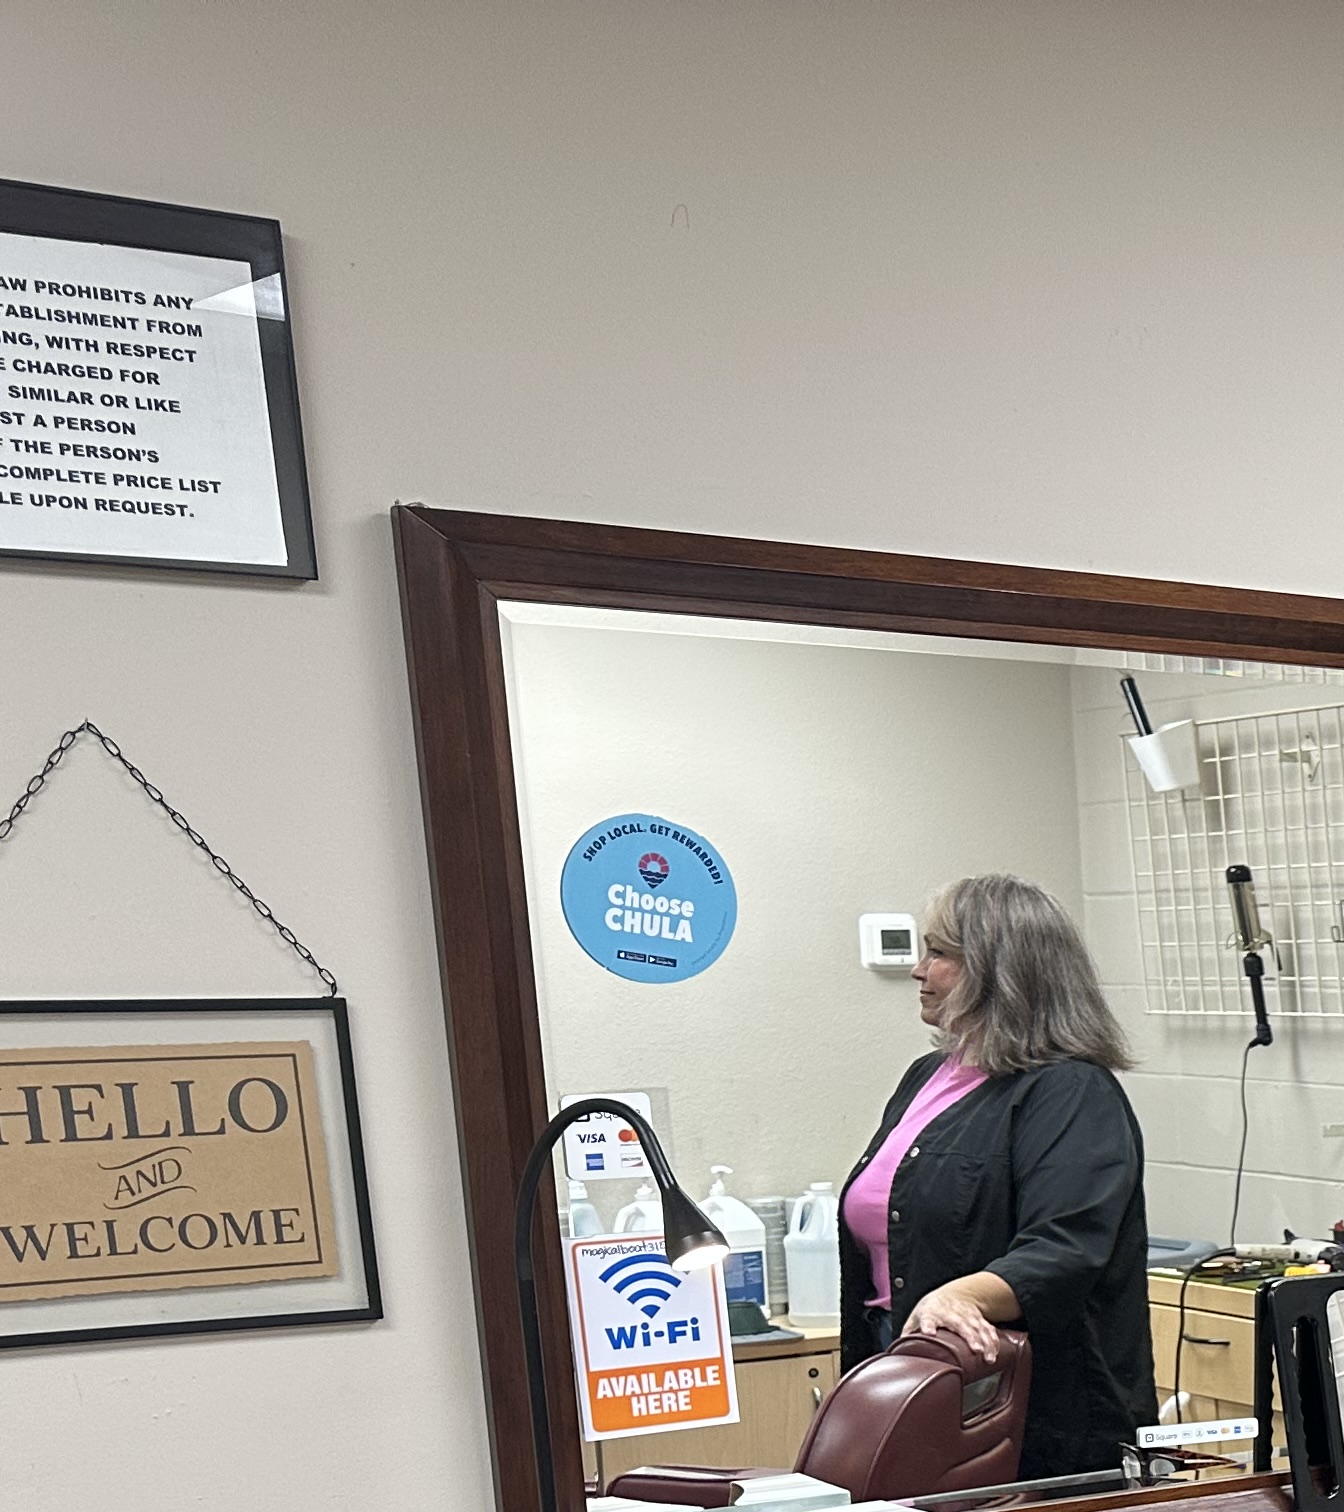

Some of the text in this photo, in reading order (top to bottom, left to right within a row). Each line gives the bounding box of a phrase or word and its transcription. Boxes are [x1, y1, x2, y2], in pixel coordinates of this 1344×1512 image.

[34, 280, 146, 305] PROHIBITS
[153, 294, 194, 310] ANY
[146, 319, 203, 338] FROM
[0, 330, 197, 363] NG, WITH RESPECT
[13, 358, 113, 381] CHARGED
[119, 369, 160, 386] FOR
[8, 385, 181, 413] SIMILAR OR LIKE
[33, 414, 48, 428] A
[53, 416, 136, 435] PERSON
[10, 438, 53, 455] THE
[0, 464, 221, 494] COMPLETE PRICE LIST
[29, 493, 88, 510] UPON
[94, 498, 195, 518] REQUEST.
[583, 823, 723, 885] SHOP LOCAL. GET REWARDED!
[607, 883, 695, 918] Choose
[604, 908, 693, 943] CHULA
[0, 1076, 289, 1146] HELLO
[576, 1133, 607, 1144] VISA
[114, 1157, 183, 1201] AND
[0, 1206, 306, 1263] WELCOME
[605, 1317, 701, 1351] Wi-Fi
[596, 1365, 721, 1400] AVAILABLE
[631, 1389, 692, 1418] HERE
